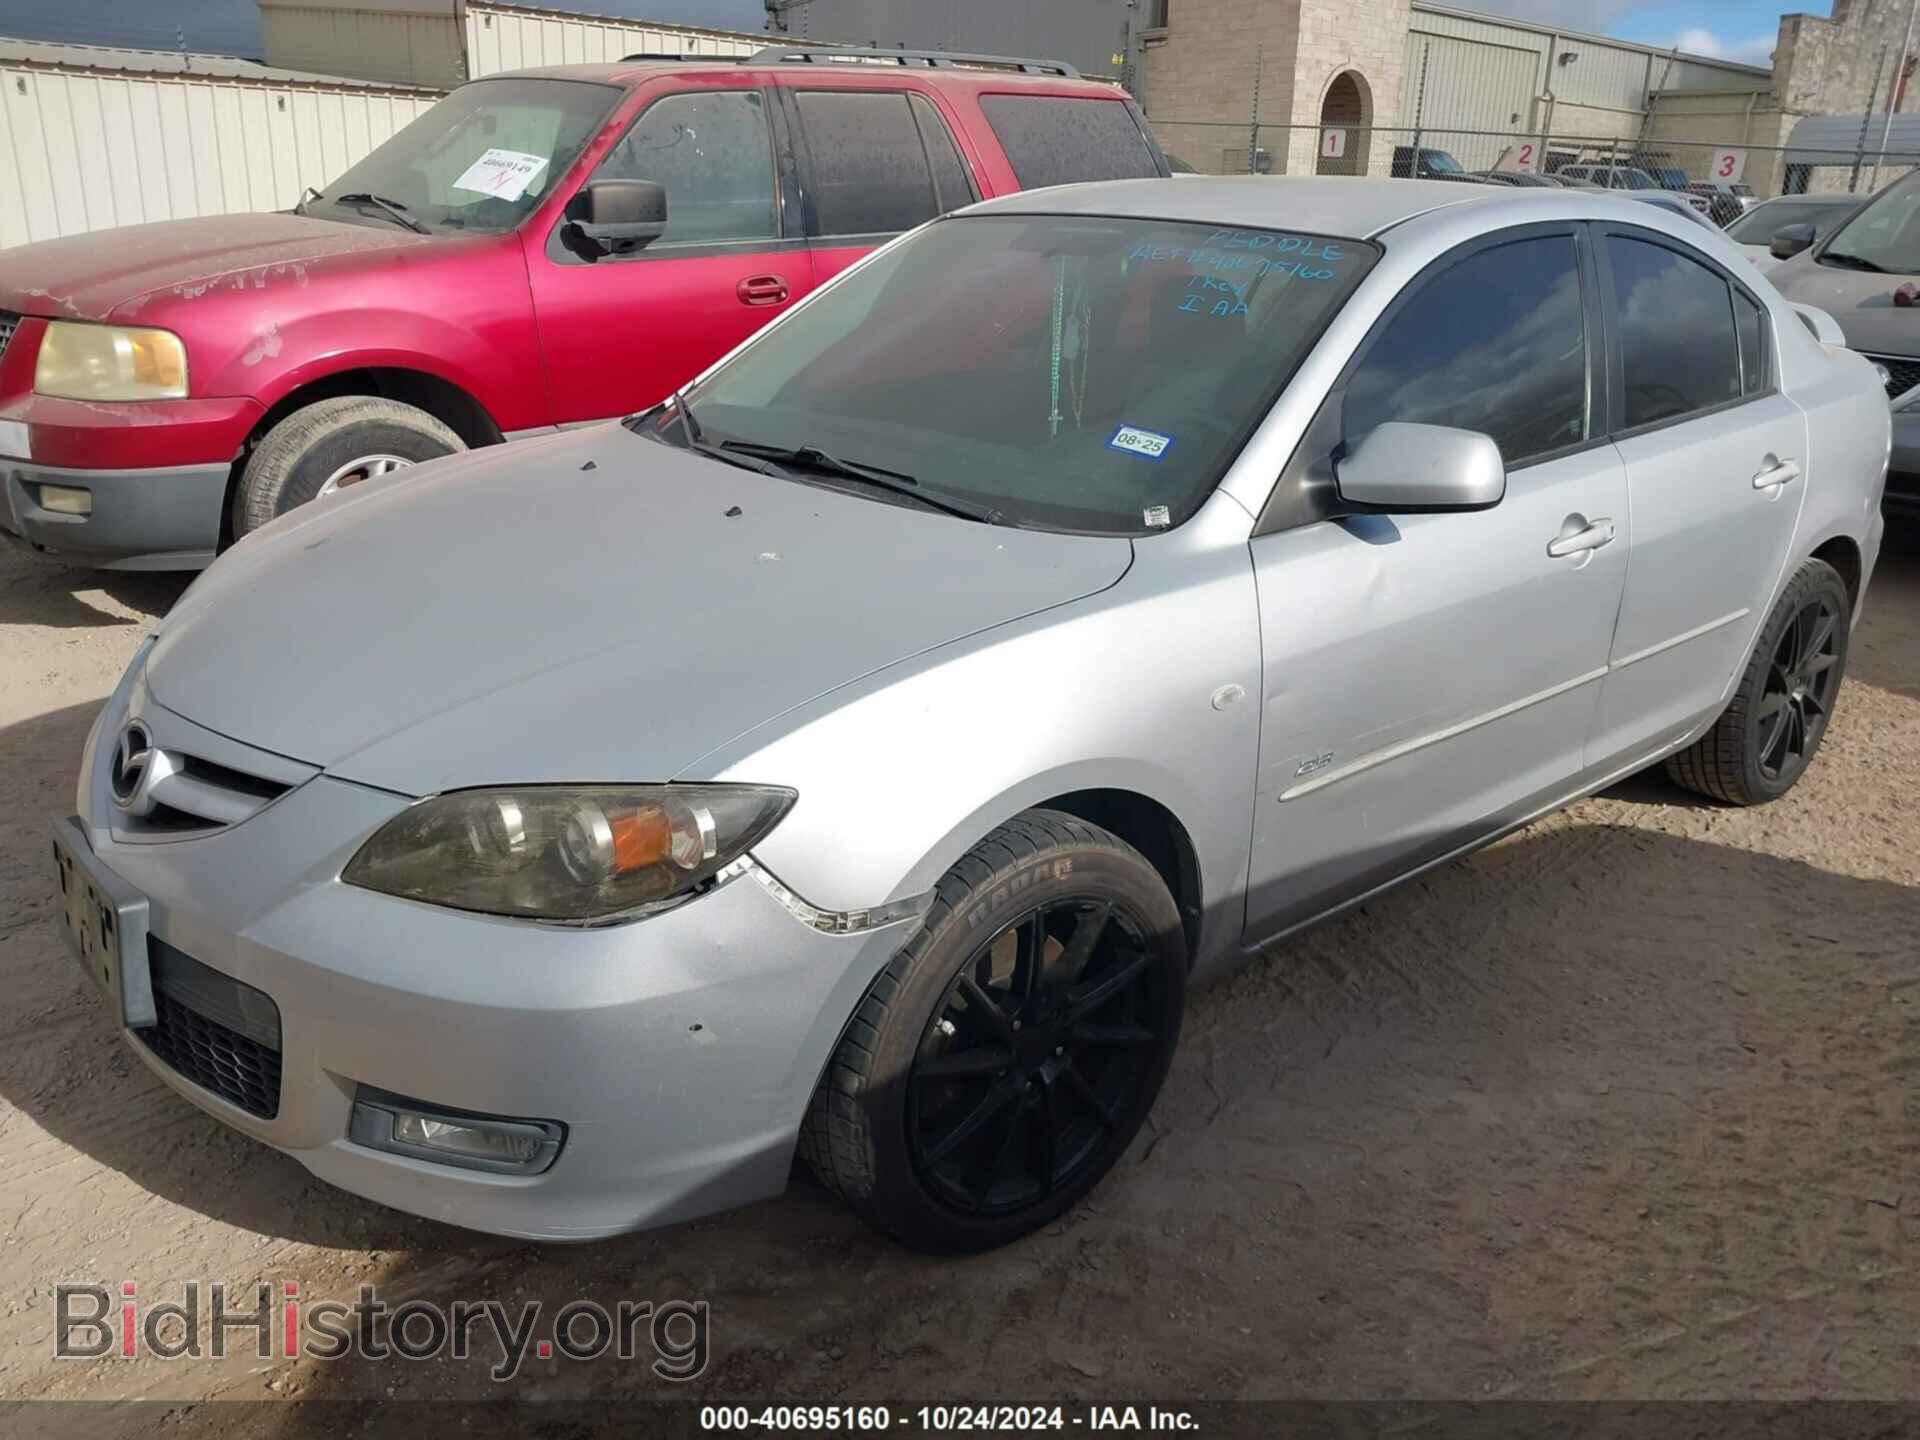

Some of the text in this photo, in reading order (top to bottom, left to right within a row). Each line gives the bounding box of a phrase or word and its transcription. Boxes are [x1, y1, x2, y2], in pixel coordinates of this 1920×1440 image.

[1329, 134, 1337, 153] 1
[1519, 144, 1532, 164] 2
[1718, 155, 1736, 178] 3
[1117, 433, 1163, 453] 08 25
